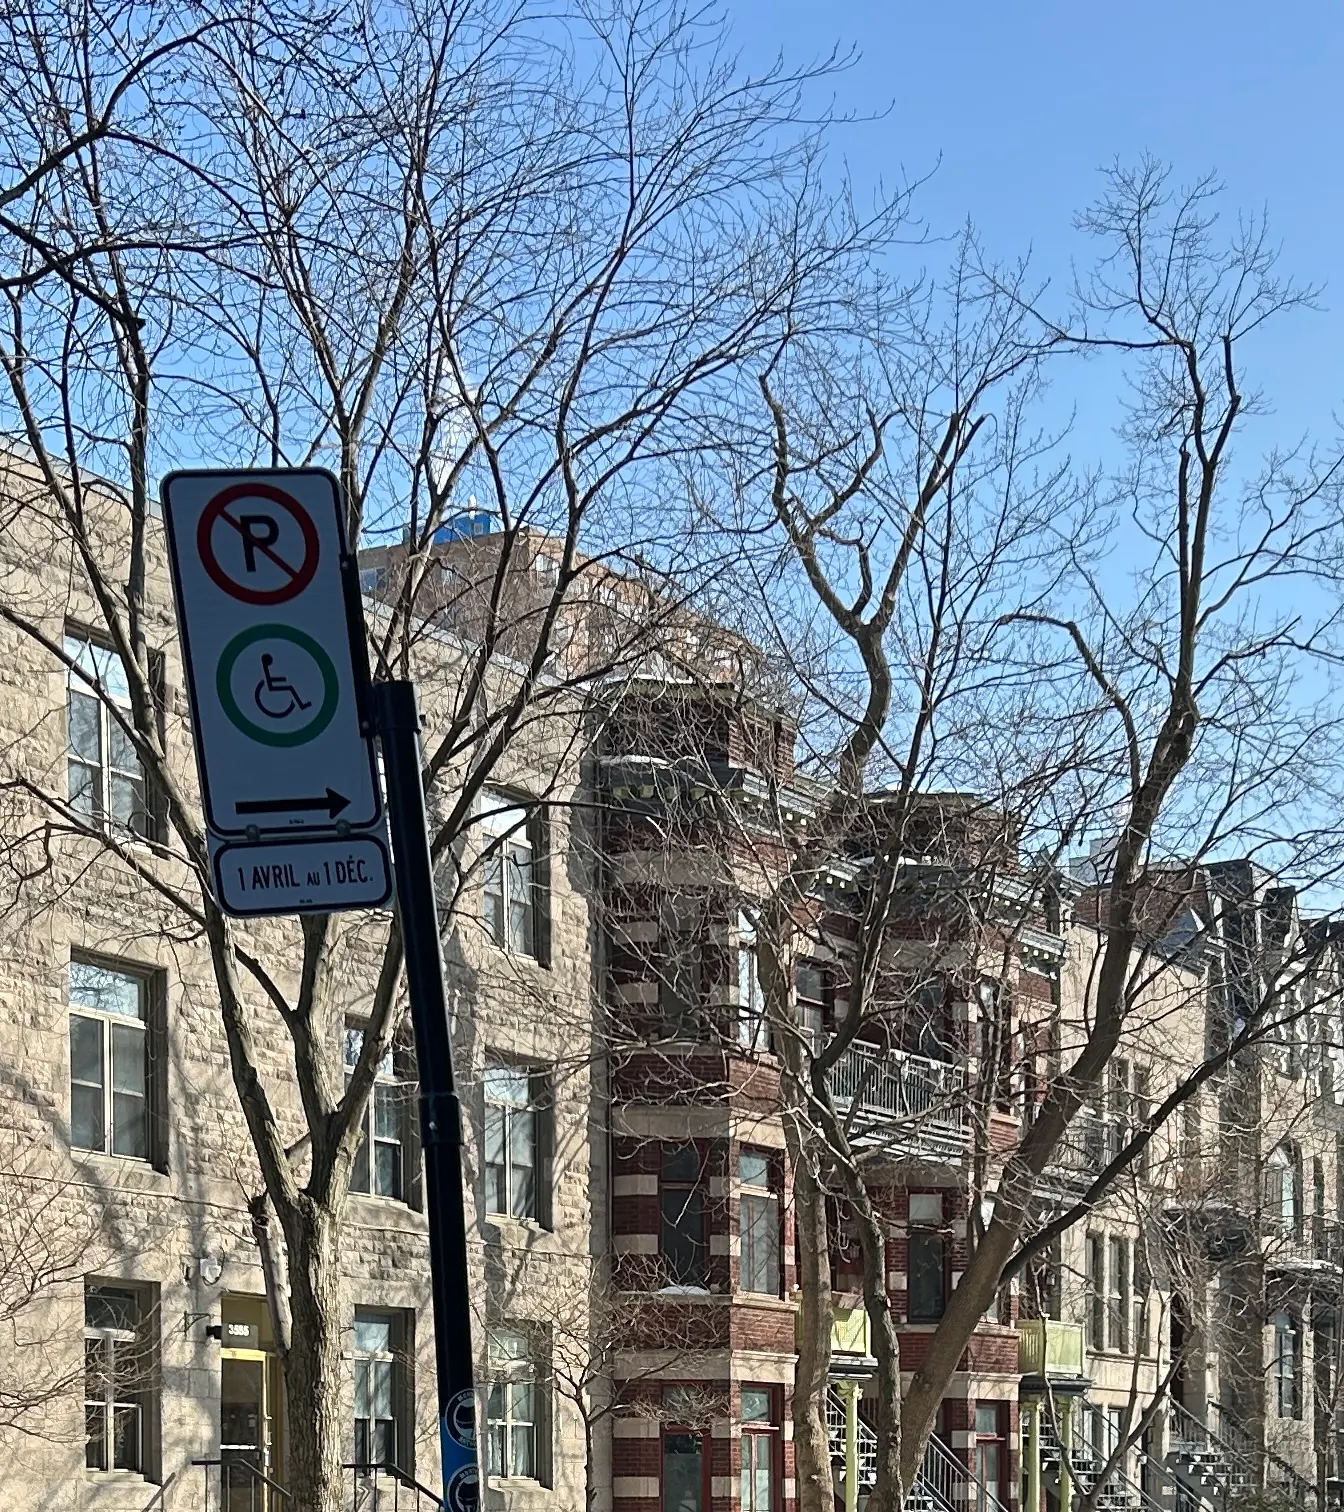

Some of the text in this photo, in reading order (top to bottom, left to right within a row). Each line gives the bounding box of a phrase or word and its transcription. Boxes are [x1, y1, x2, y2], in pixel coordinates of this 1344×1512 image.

[239, 515, 280, 573] P
[237, 854, 374, 891] 1 AVRIL AU 1 DÉC.
